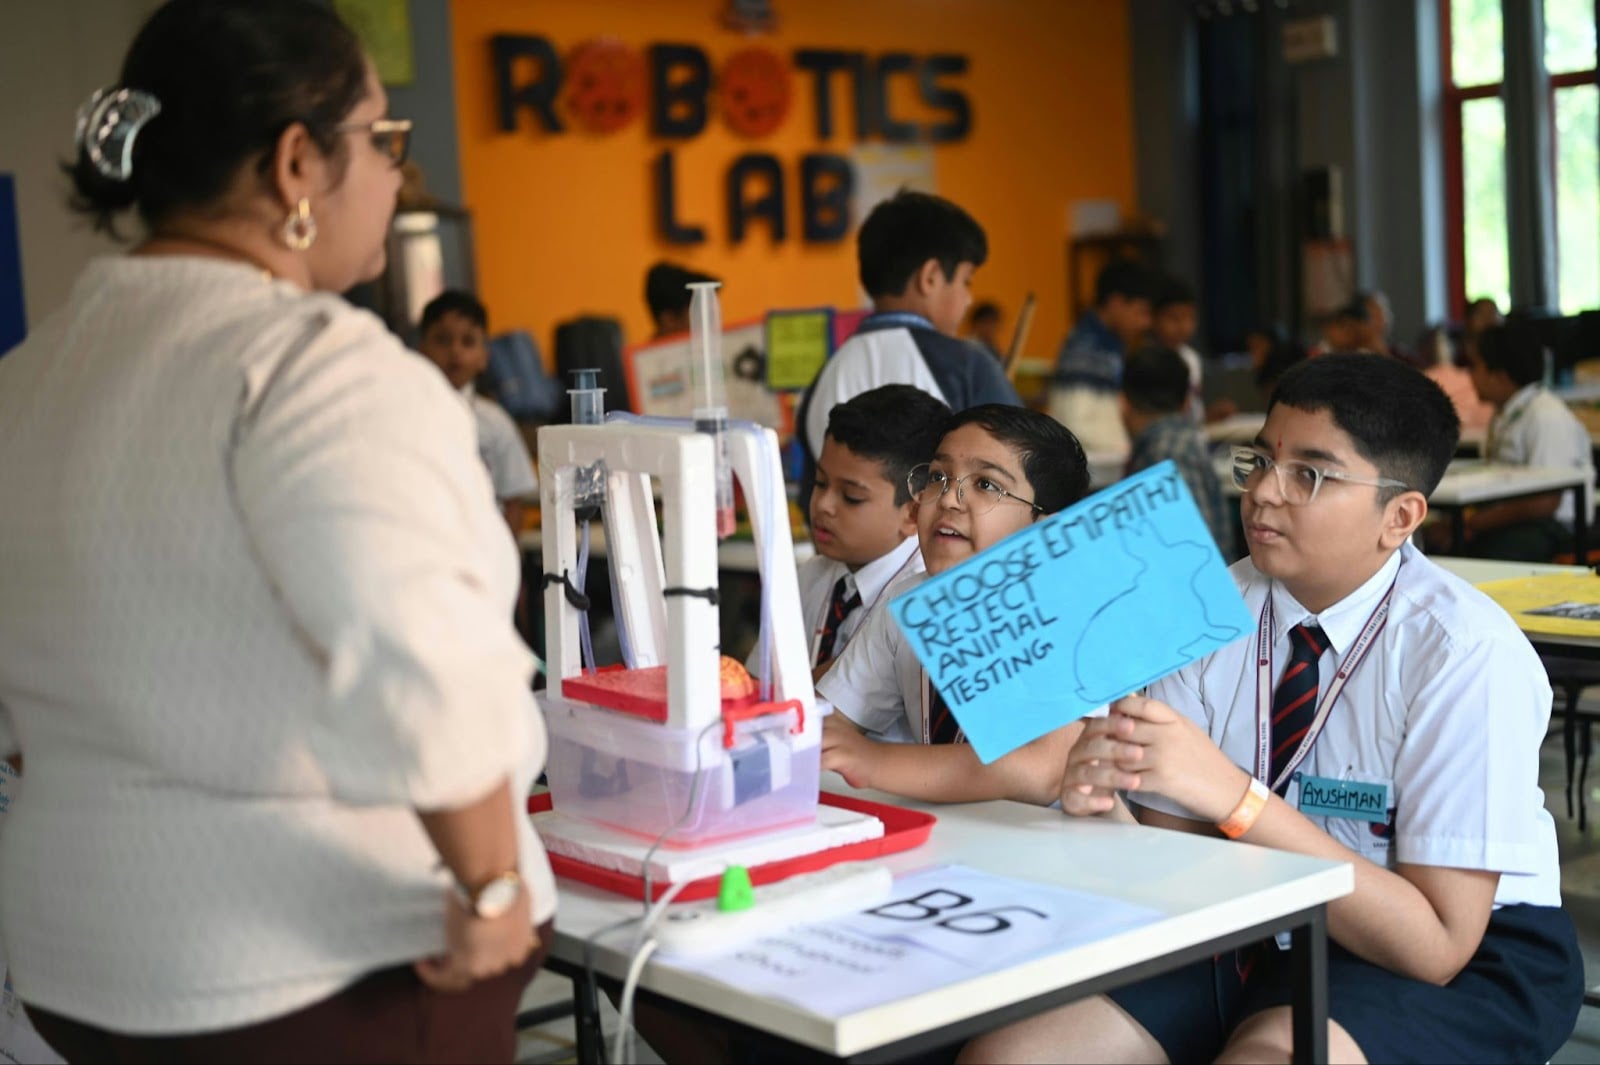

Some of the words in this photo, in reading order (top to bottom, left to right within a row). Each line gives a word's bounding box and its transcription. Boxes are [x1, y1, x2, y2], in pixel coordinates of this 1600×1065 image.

[486, 33, 975, 143] ROBOTICS
[653, 150, 856, 245] LAB
[900, 540, 1042, 630] CHOOSE
[1041, 473, 1182, 561] EMPATHY
[916, 574, 1038, 658] REJECT
[937, 607, 1059, 680] ANIMAL
[942, 639, 1054, 707] TESTING
[1301, 780, 1384, 810] AYUSHMAN
[862, 887, 1051, 936] B6
